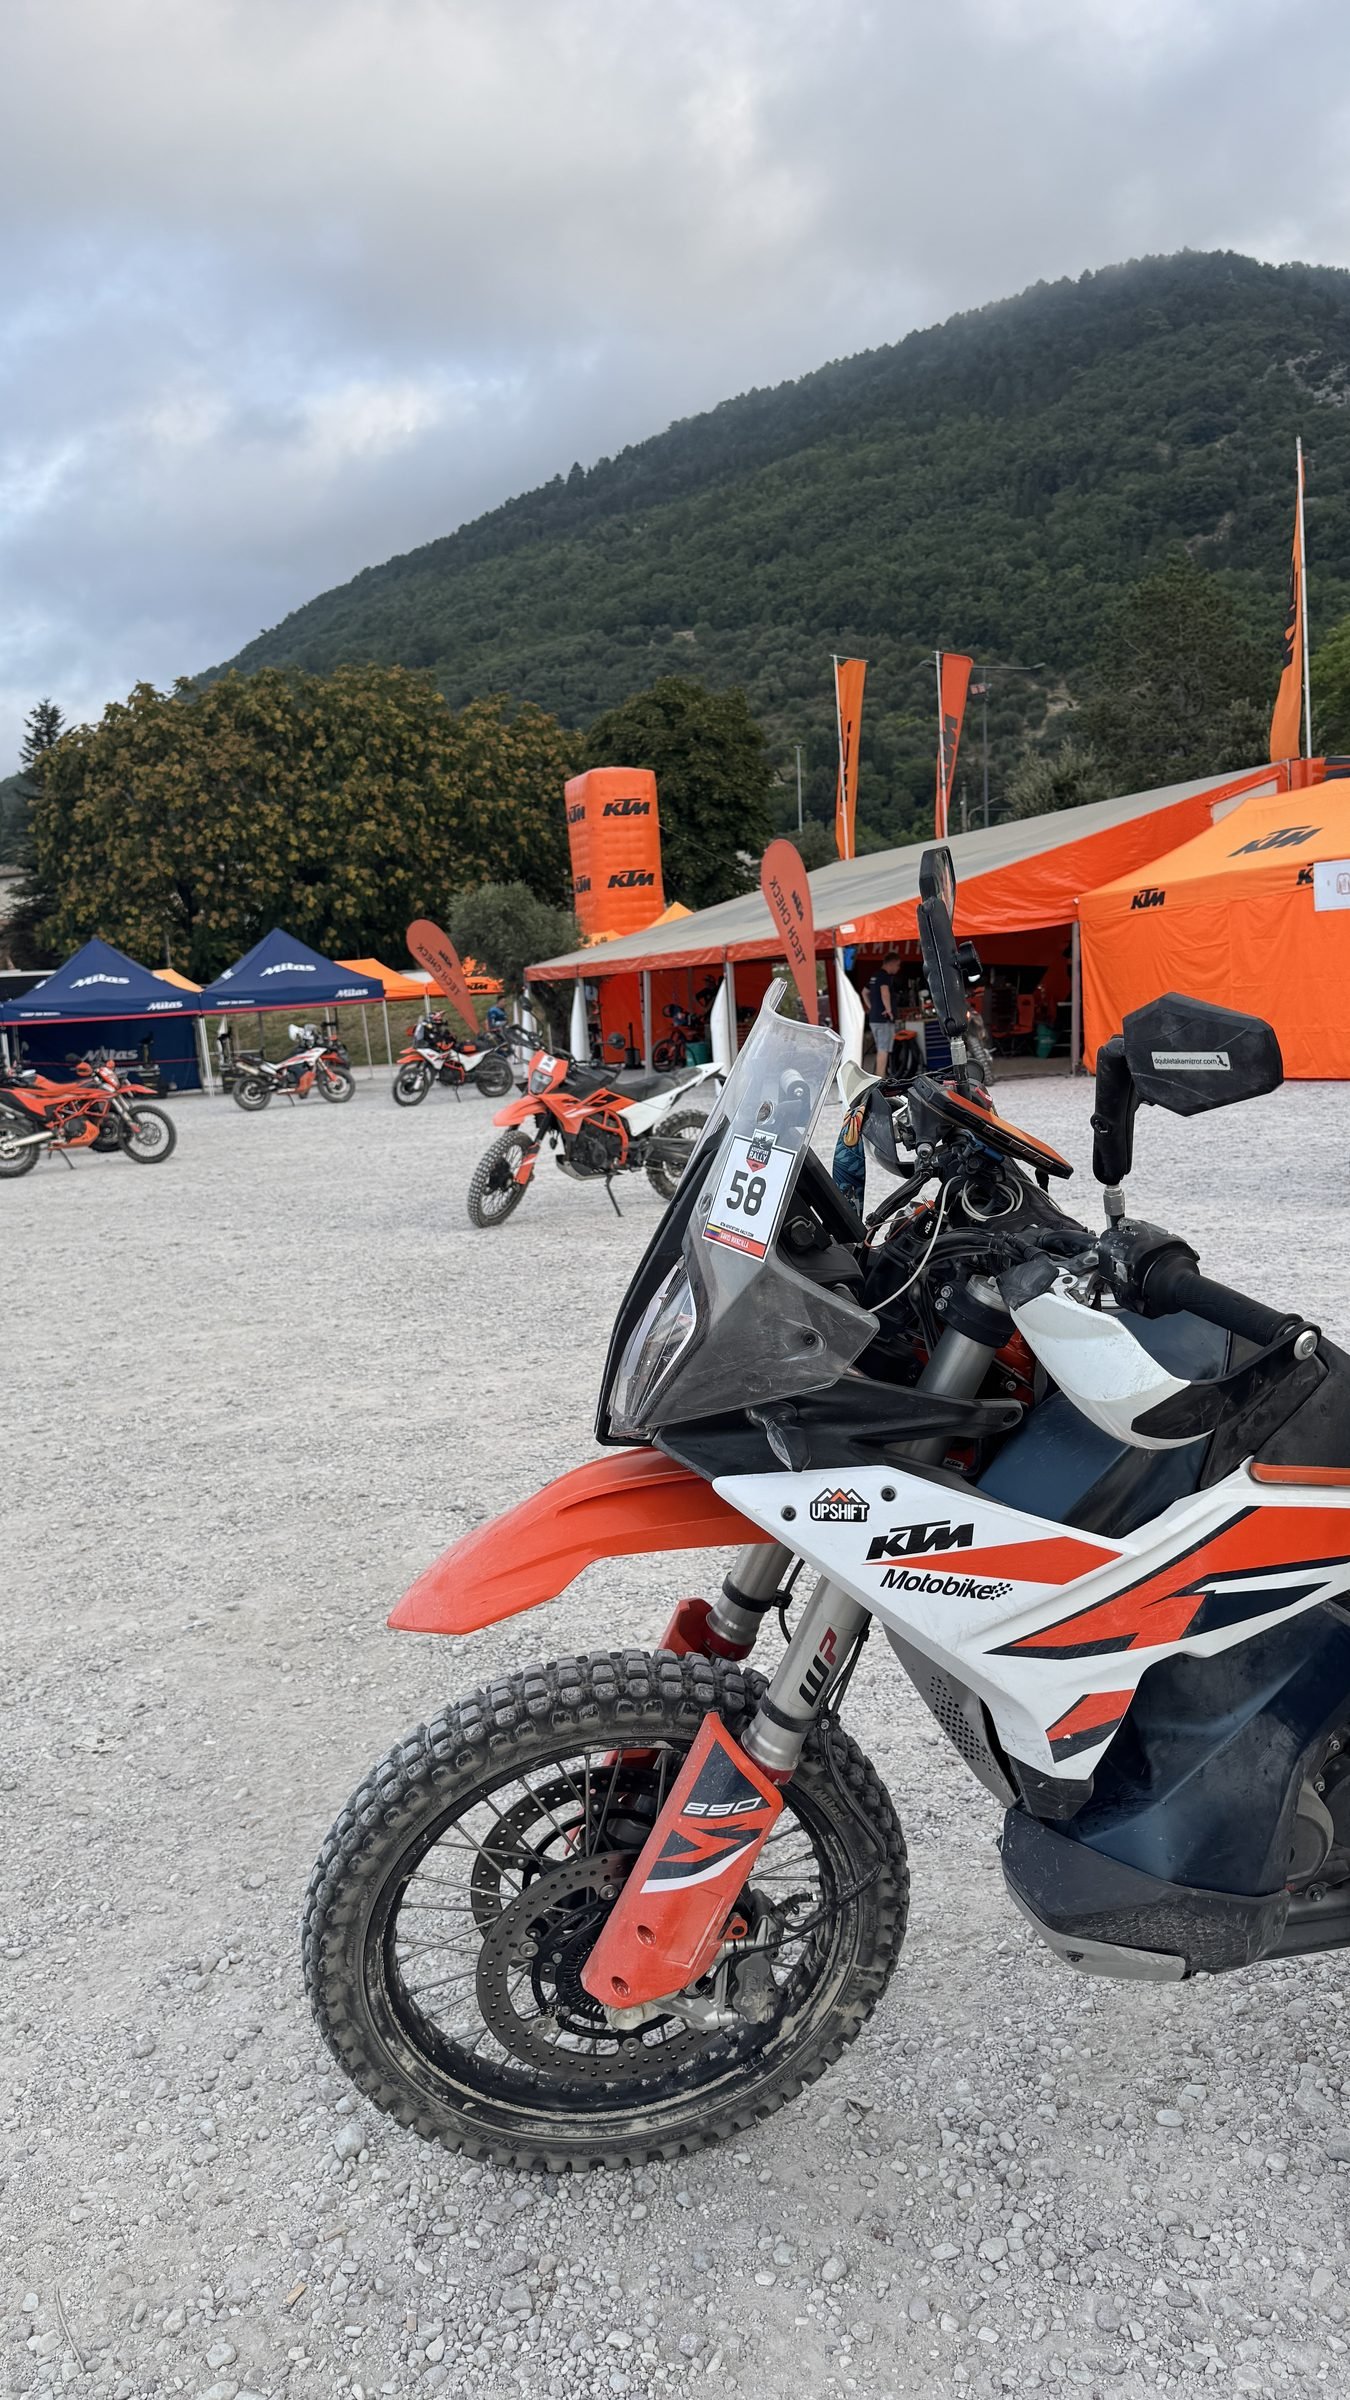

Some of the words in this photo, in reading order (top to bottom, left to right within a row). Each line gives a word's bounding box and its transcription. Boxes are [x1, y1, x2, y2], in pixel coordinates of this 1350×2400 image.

[602, 798, 650, 816] KTM
[1227, 825, 1323, 858] KTM
[607, 869, 654, 888] KTM
[1131, 888, 1166, 909] KTM
[260, 962, 317, 978] Mitas
[69, 973, 131, 989] Mitas
[335, 988, 369, 998] Mitas
[147, 1001, 184, 1012] Mitas
[726, 1169, 767, 1217] 58
[811, 1503, 868, 1520] UPSHIFT
[866, 1520, 975, 1560] KTM
[880, 1568, 994, 1600] Motobike
[799, 1626, 838, 1707] WP
[683, 1796, 763, 1817] 890
[455, 2118, 529, 2151] ENDUR
